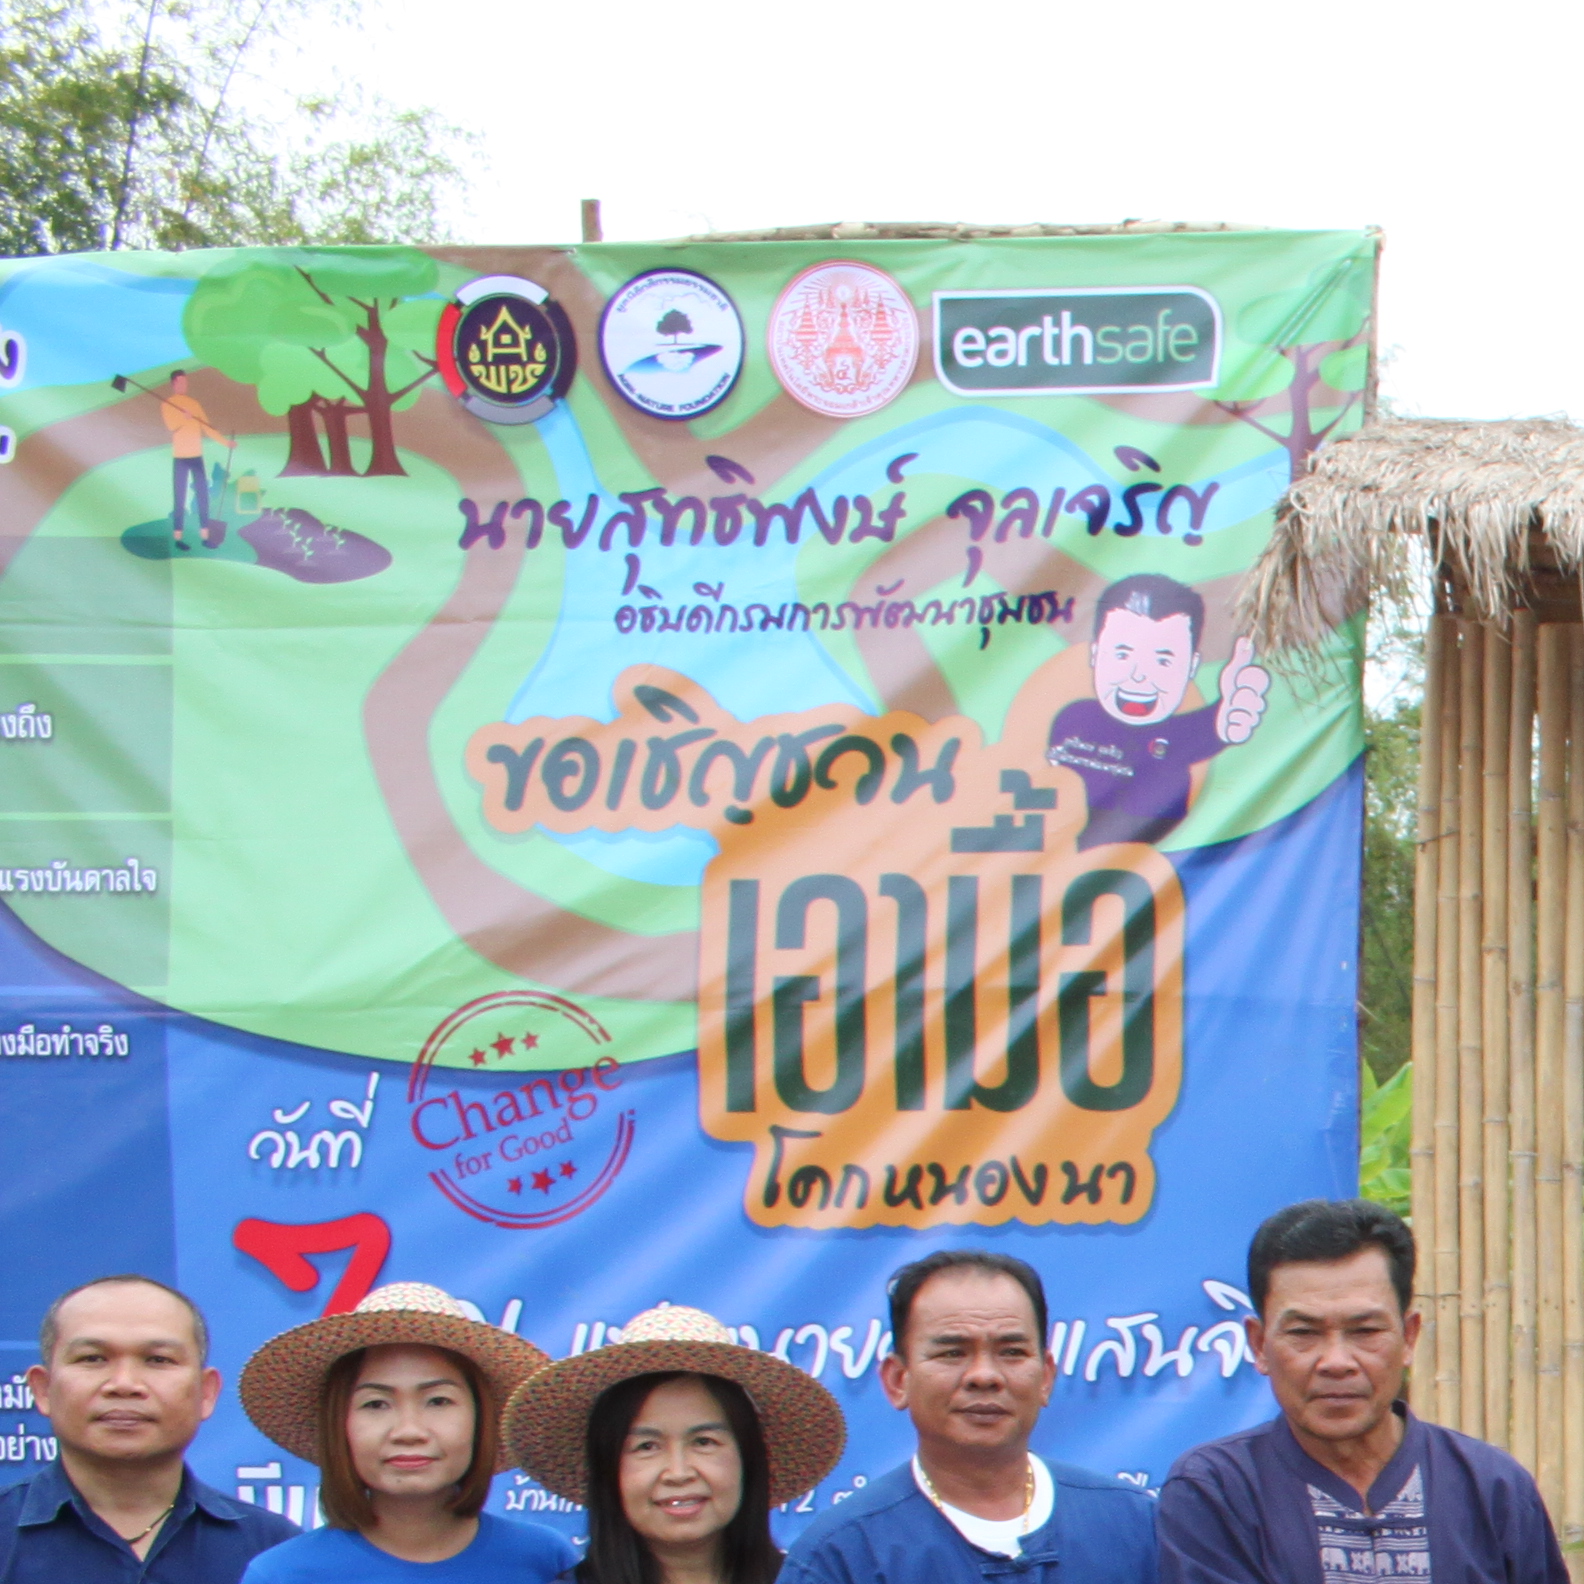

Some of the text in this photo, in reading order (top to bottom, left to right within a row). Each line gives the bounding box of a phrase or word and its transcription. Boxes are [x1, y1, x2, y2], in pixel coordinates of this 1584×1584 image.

[951, 308, 1198, 370] earthsafe
[458, 445, 1221, 597] นายสุทธิพงษ์ จุลเจริญ
[613, 578, 1076, 651] อธิบดีกรมการพัฒนาชุมชน
[488, 685, 962, 824] ขอเชิญชวน
[0, 858, 157, 892] แรงบันดาลใจ
[724, 770, 1157, 1115] เอามื้อ
[249, 1072, 380, 1168] วันที่
[410, 1055, 623, 1150] Change
[453, 1116, 574, 1181] for Good
[1051, 1279, 1257, 1382] แสนจิ
